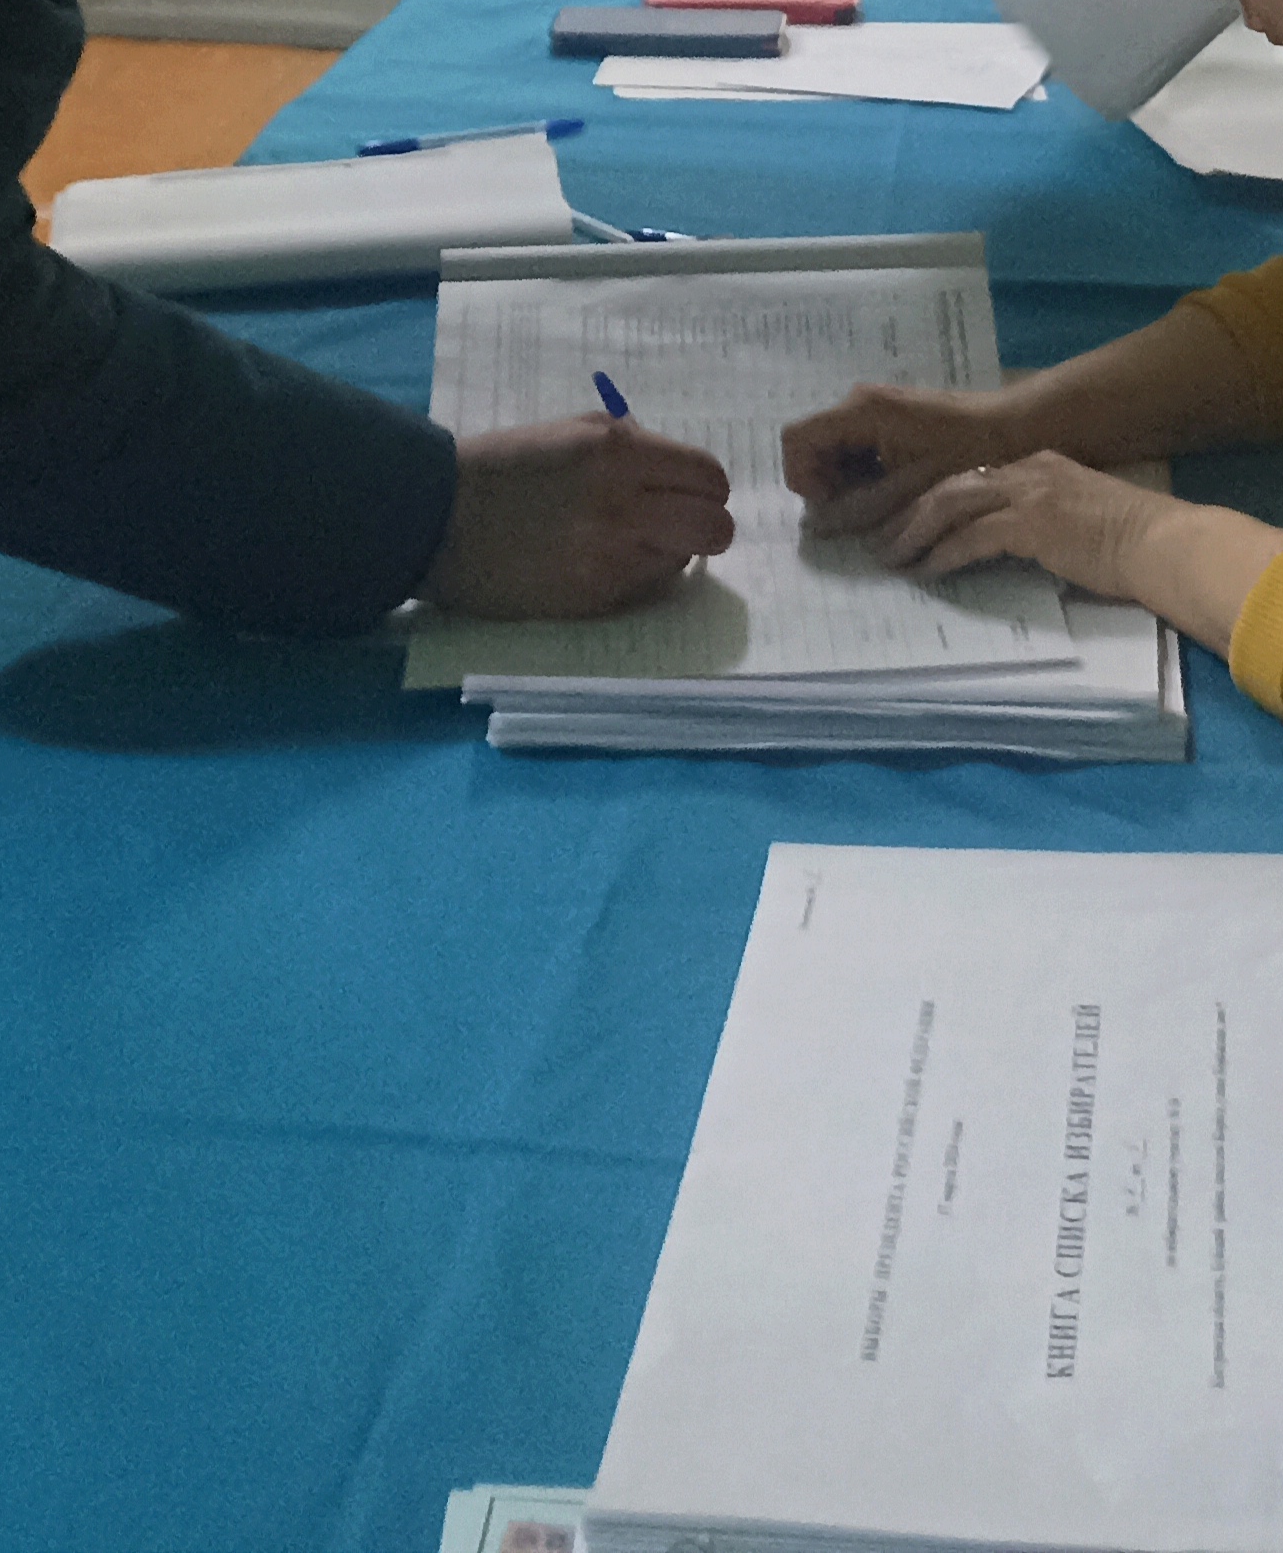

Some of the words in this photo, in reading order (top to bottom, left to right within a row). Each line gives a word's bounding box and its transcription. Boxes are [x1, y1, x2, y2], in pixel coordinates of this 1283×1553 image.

[1062, 1003, 1101, 1162] ИЗБИРАТЕЛЕЙ
[1052, 1171, 1089, 1279] СПИСКА
[1044, 1288, 1080, 1380] КНИГА
